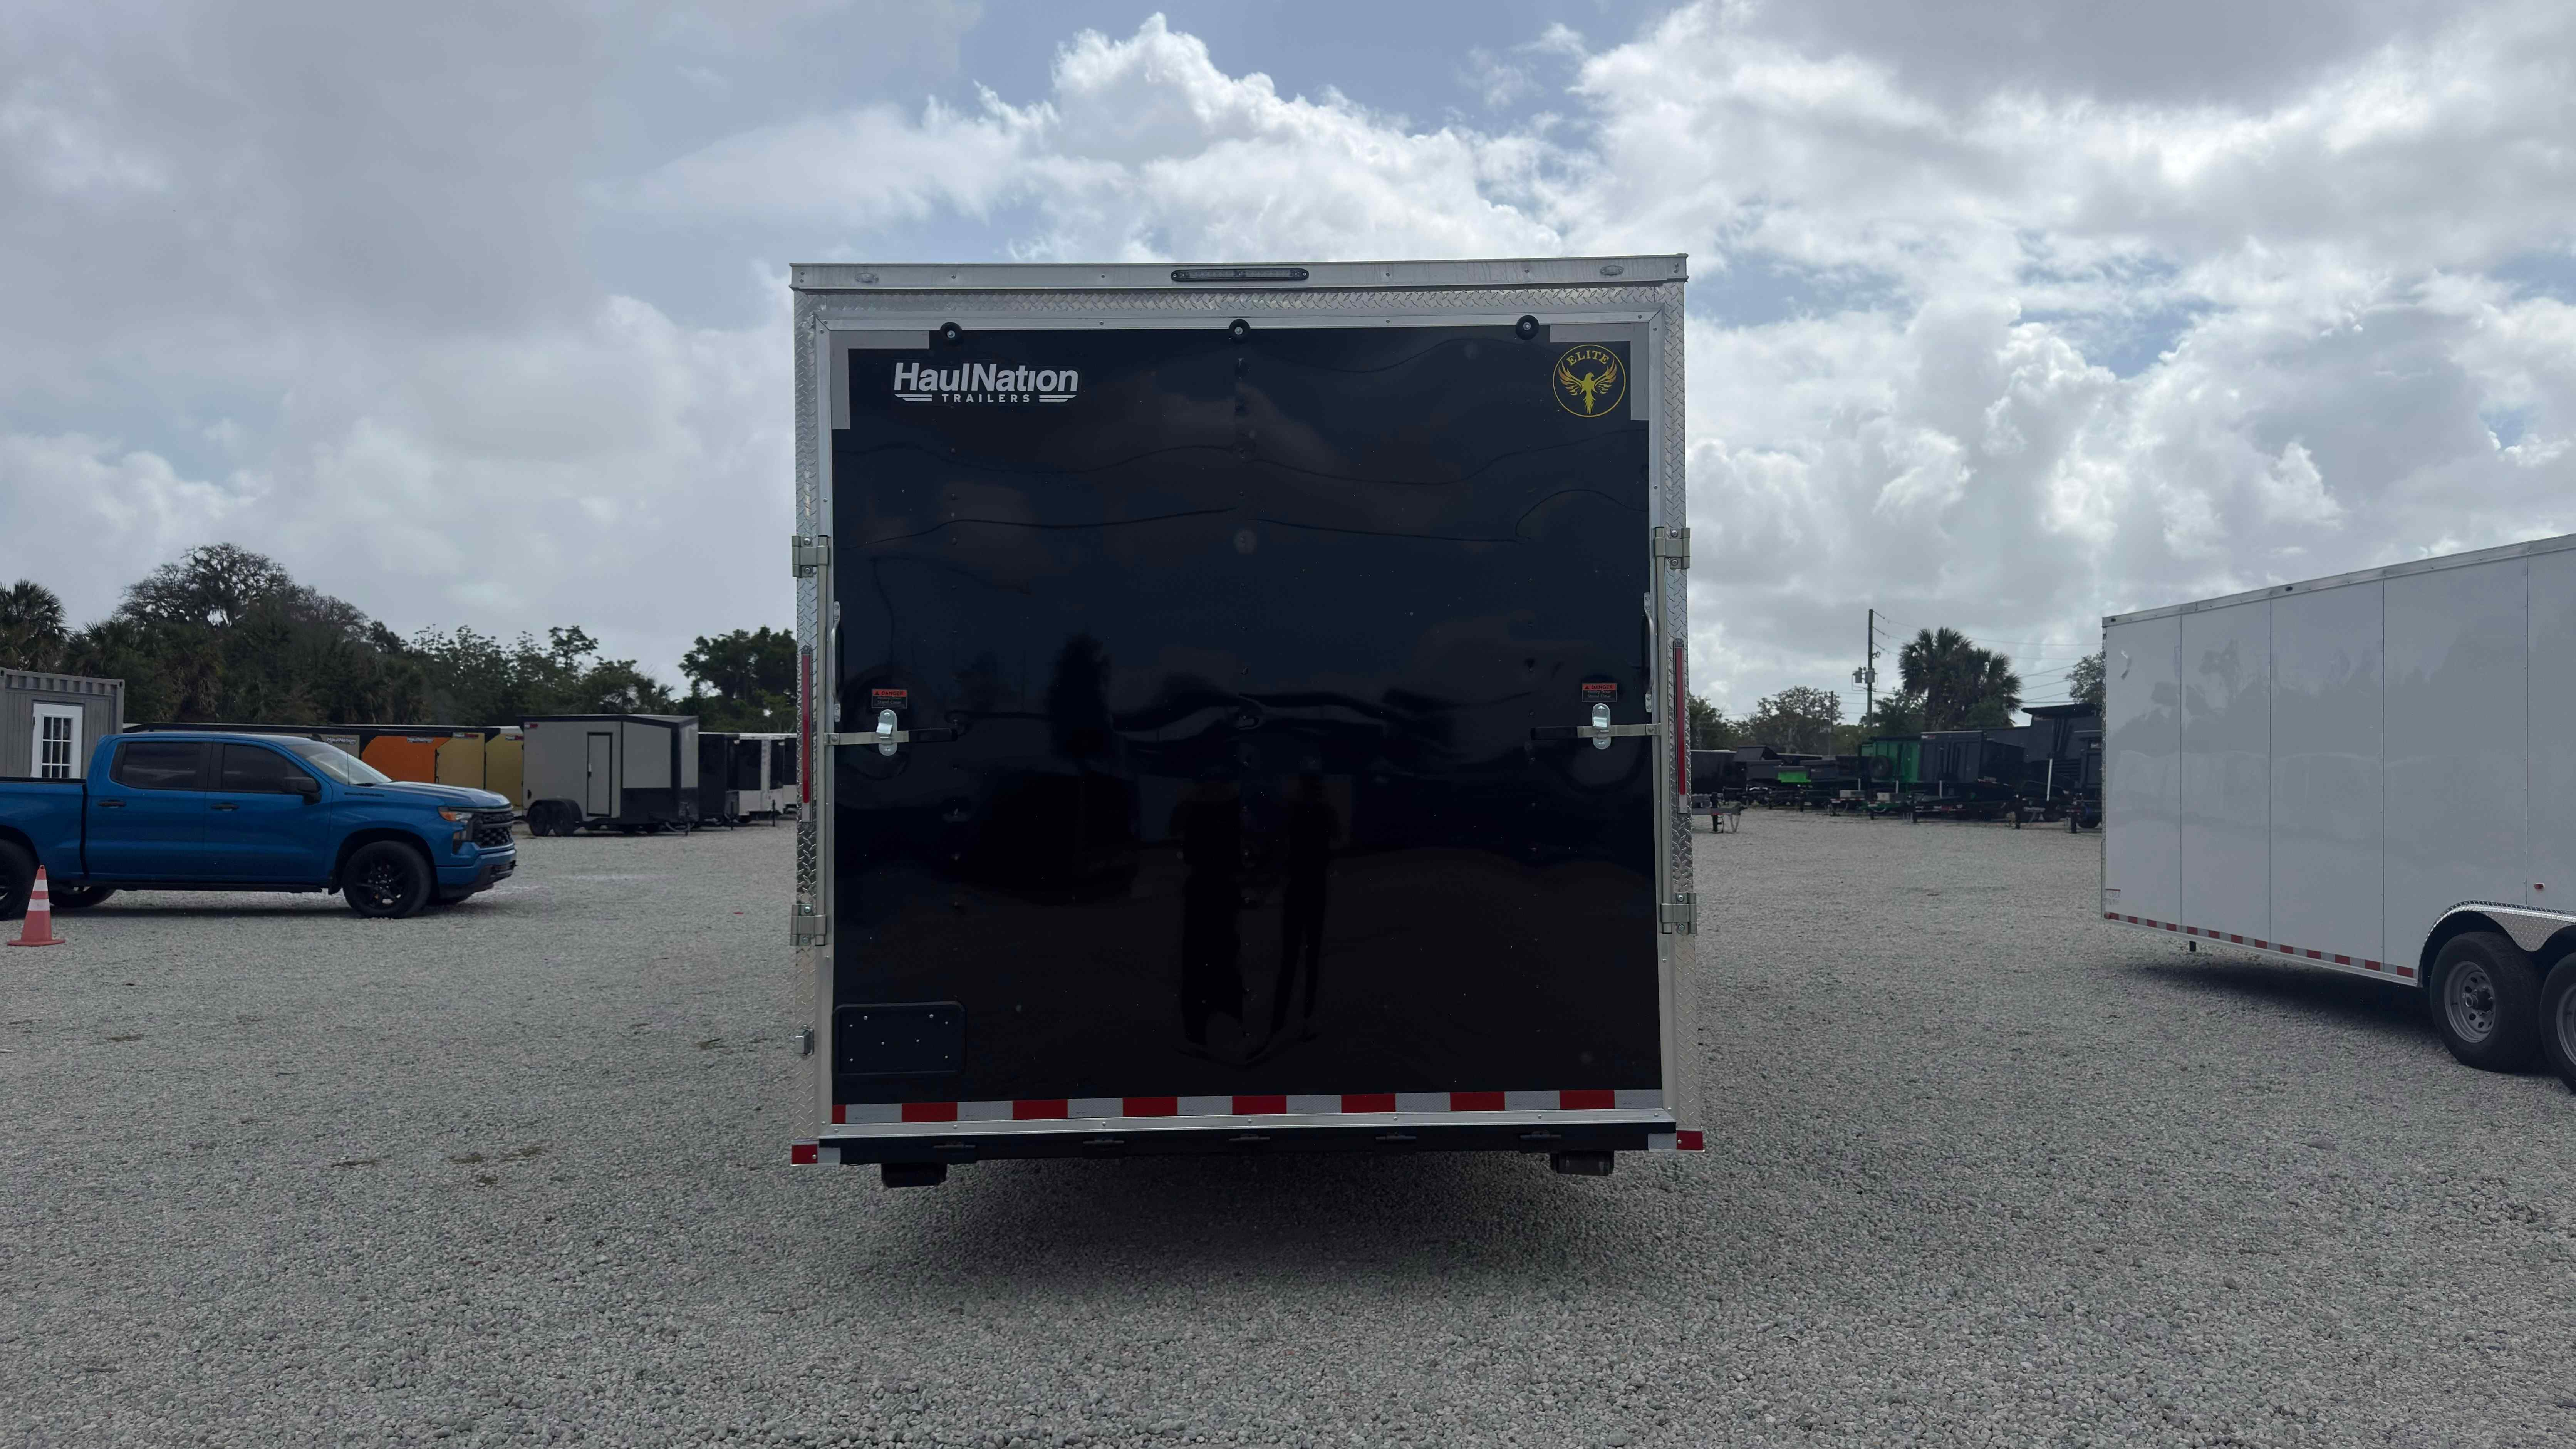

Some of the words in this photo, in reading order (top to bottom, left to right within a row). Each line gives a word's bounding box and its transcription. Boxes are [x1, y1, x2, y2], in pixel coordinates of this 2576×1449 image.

[1566, 350, 1609, 366] ELITE
[894, 362, 1078, 392] HaulNation
[941, 394, 1030, 403] TRAILERS
